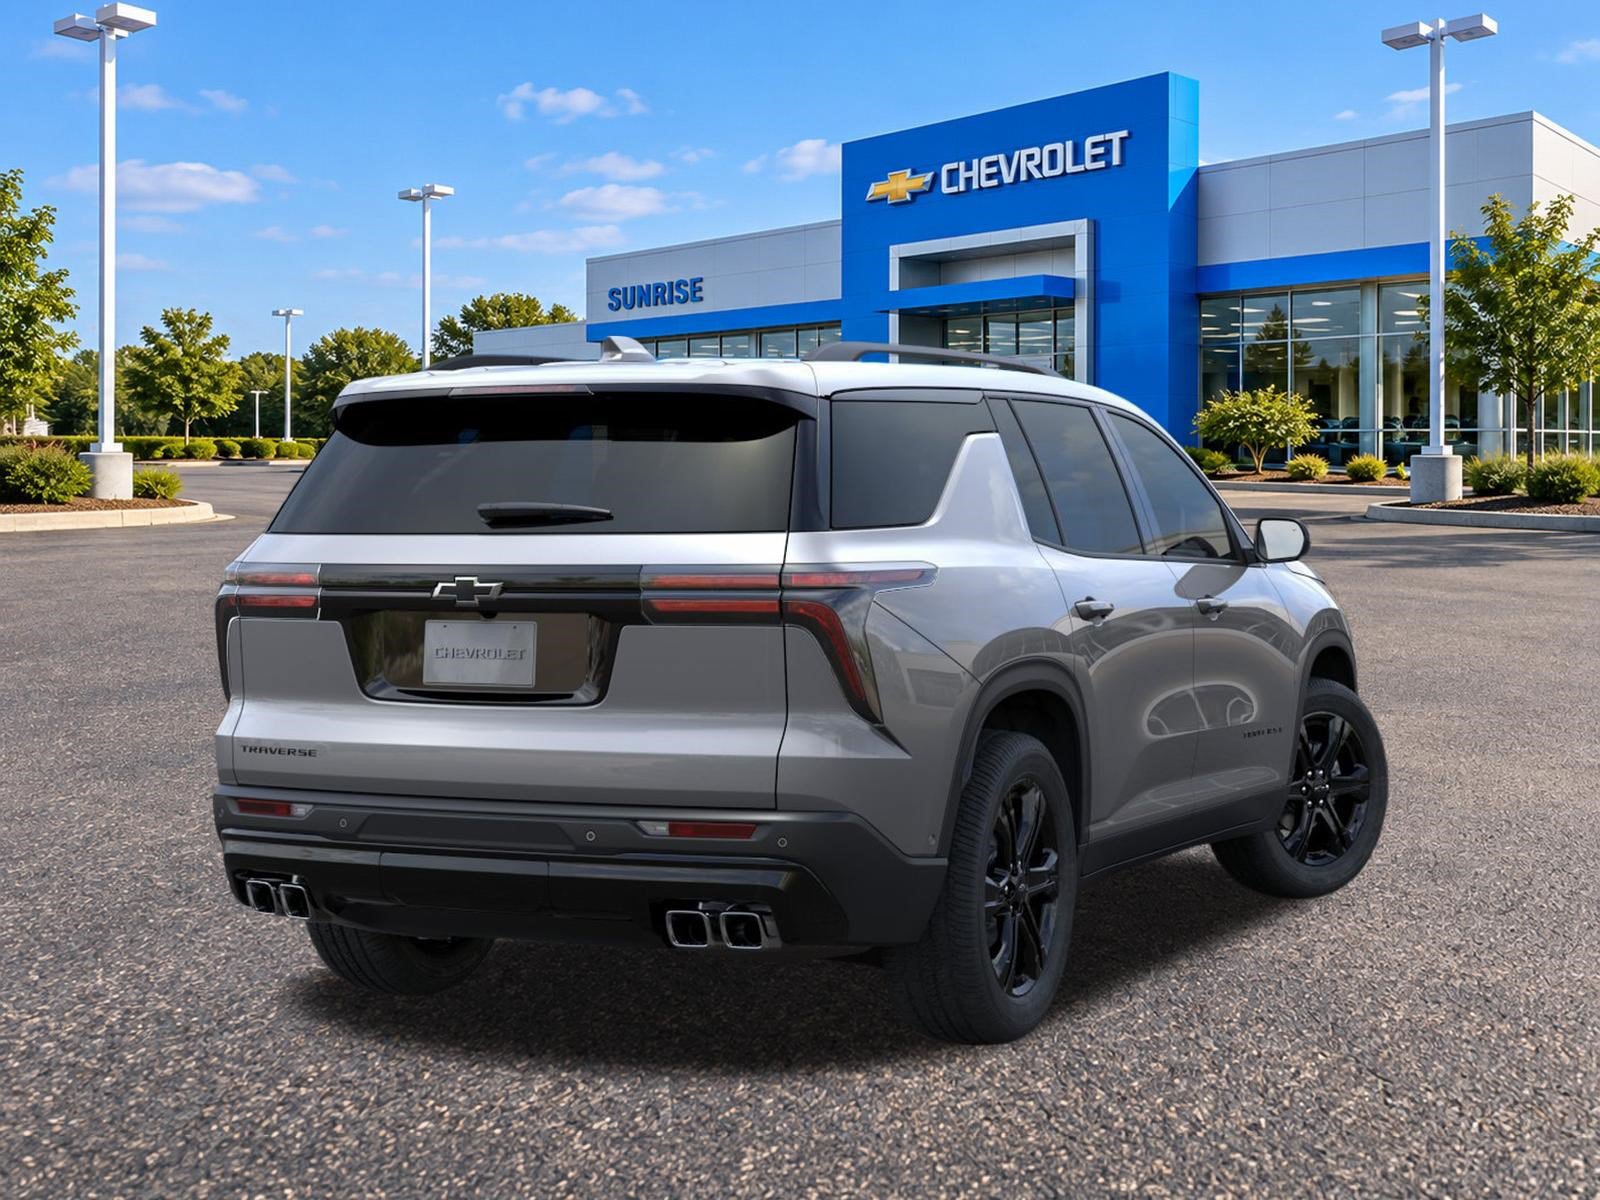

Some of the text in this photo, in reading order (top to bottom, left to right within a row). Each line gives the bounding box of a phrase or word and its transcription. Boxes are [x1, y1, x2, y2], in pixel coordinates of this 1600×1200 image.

[941, 130, 1129, 194] CHEVROLET
[608, 277, 704, 312] SUNRISE
[435, 647, 527, 661] CHEVROLET
[241, 745, 318, 758] TRAVERSE
